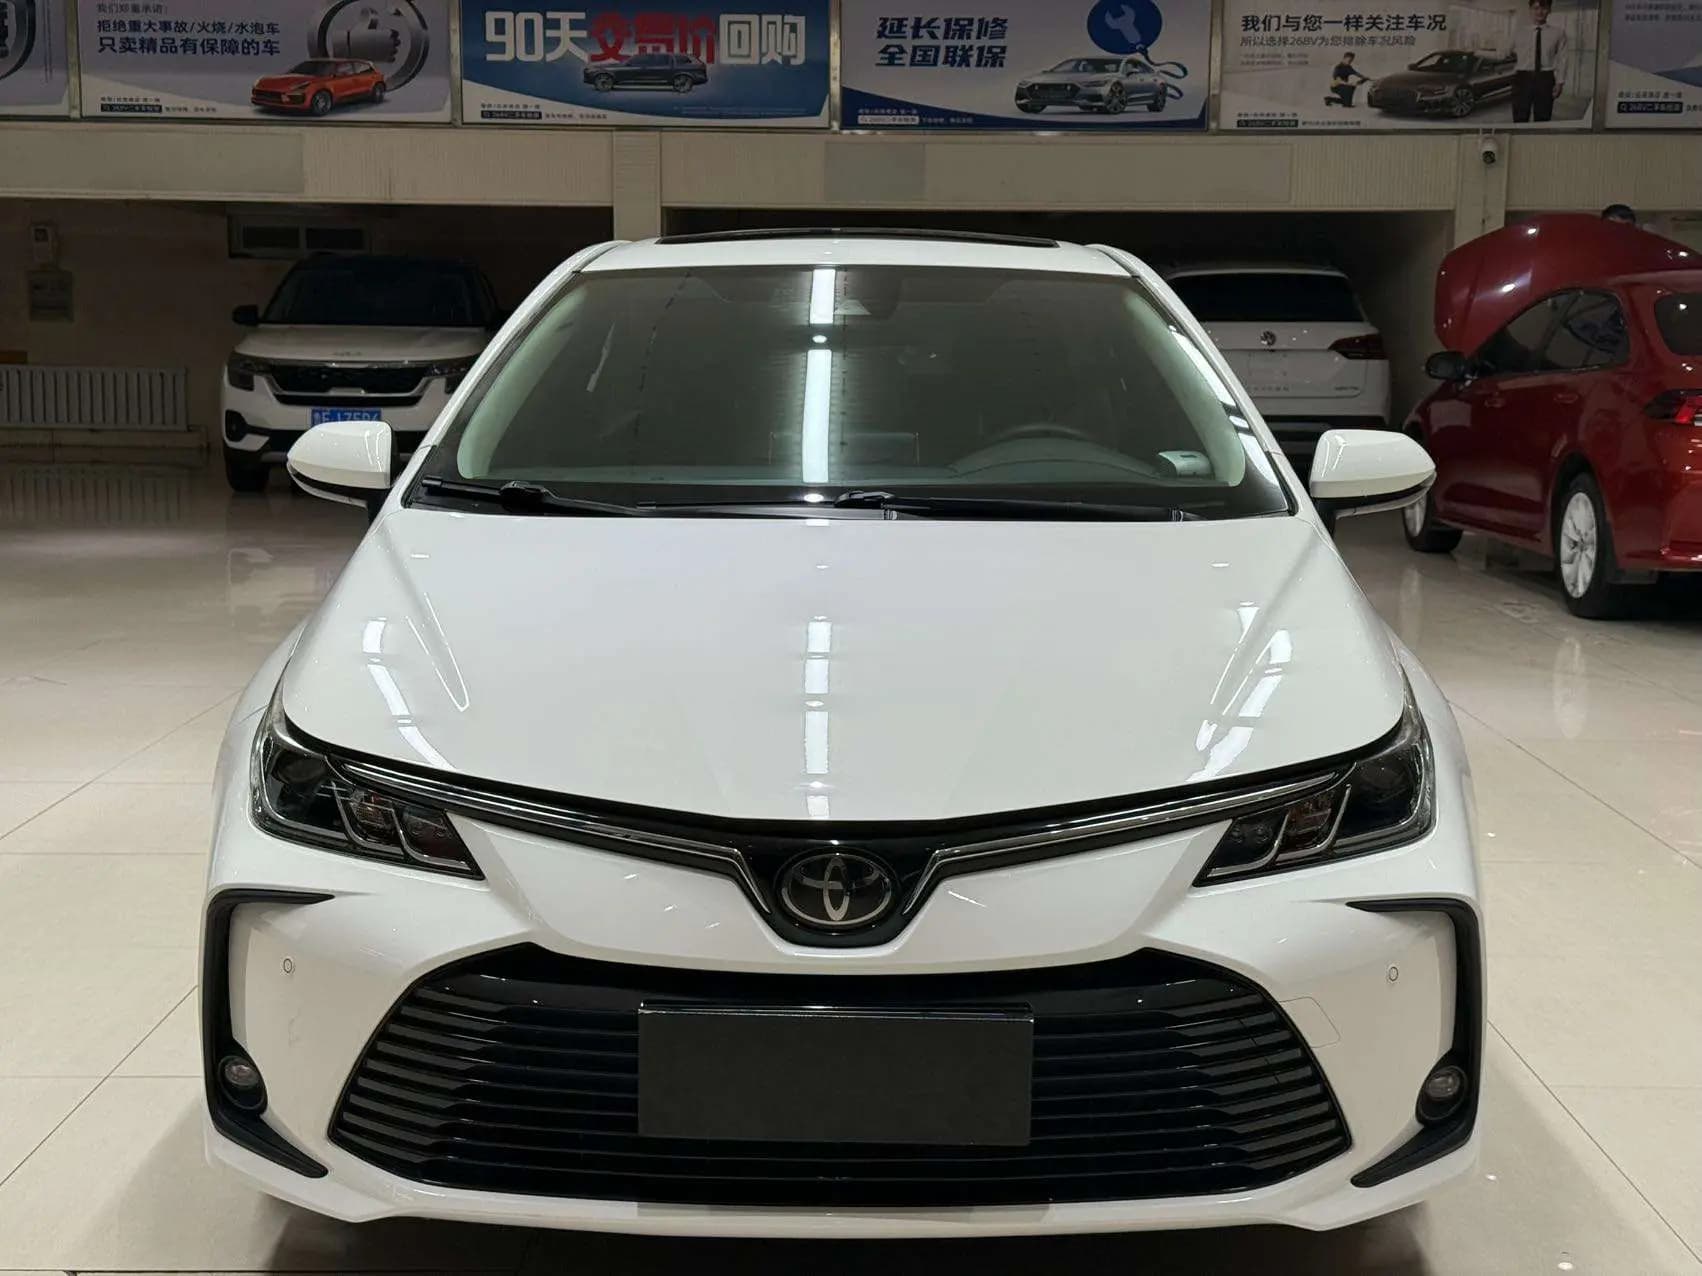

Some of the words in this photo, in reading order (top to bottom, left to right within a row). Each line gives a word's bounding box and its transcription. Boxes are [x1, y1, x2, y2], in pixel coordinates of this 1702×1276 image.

[97, 20, 280, 35] 拒绝重大事故/火烧/水泡车
[876, 17, 1008, 41] 延长保修
[1241, 13, 1447, 32] 我们与您一样关注车况
[97, 36, 281, 56] 只卖精品有保障的车
[875, 43, 1008, 68] 全国联保
